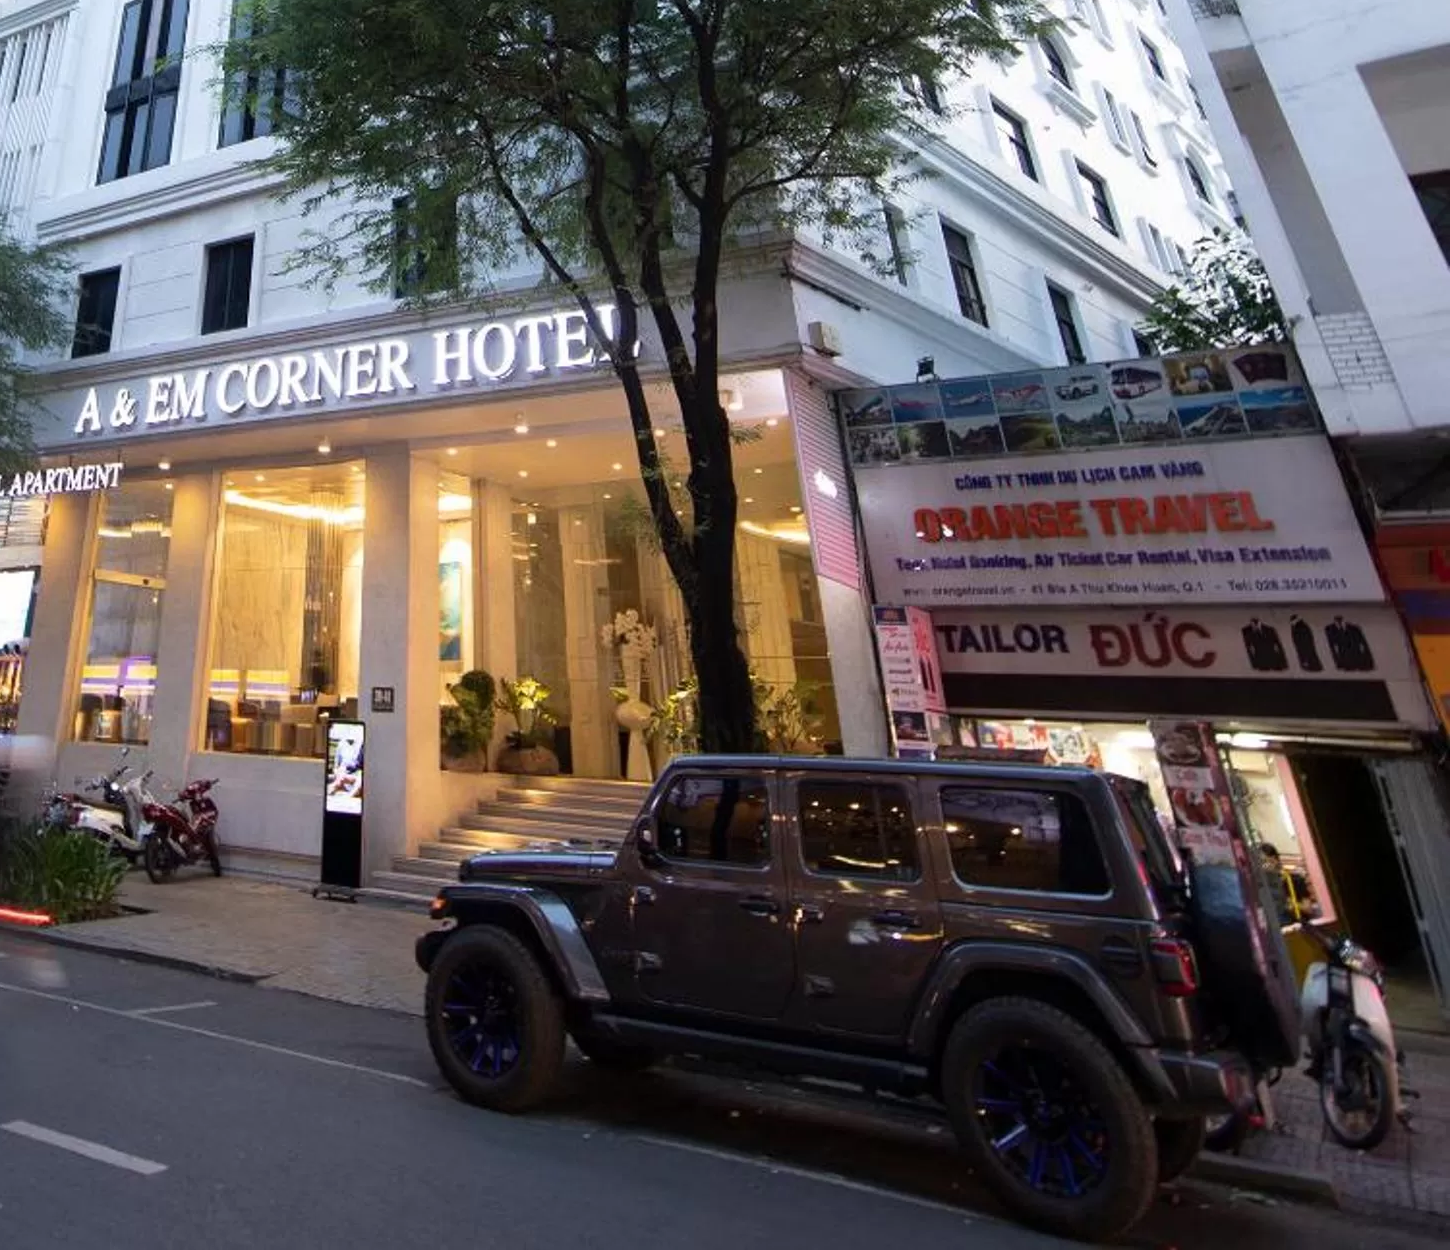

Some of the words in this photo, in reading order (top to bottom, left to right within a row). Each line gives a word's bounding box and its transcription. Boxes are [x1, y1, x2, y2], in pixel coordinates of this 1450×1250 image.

[74, 387, 102, 434] A
[109, 387, 137, 428] &
[144, 370, 211, 424] EM
[215, 337, 417, 415] CORNER
[7, 462, 125, 498] APARTMENT
[996, 473, 1014, 490] TY
[1057, 469, 1078, 486] DU
[1119, 464, 1156, 482] CAM
[913, 500, 1089, 544] ORANGE
[1090, 491, 1276, 537] TRAVEL
[1035, 553, 1055, 568] Air
[1105, 550, 1133, 566] Car
[1197, 547, 1235, 564] Visa
[1238, 544, 1333, 564] Extension
[934, 623, 1070, 654] TAILOR
[1088, 610, 1218, 669] ĐỨC
